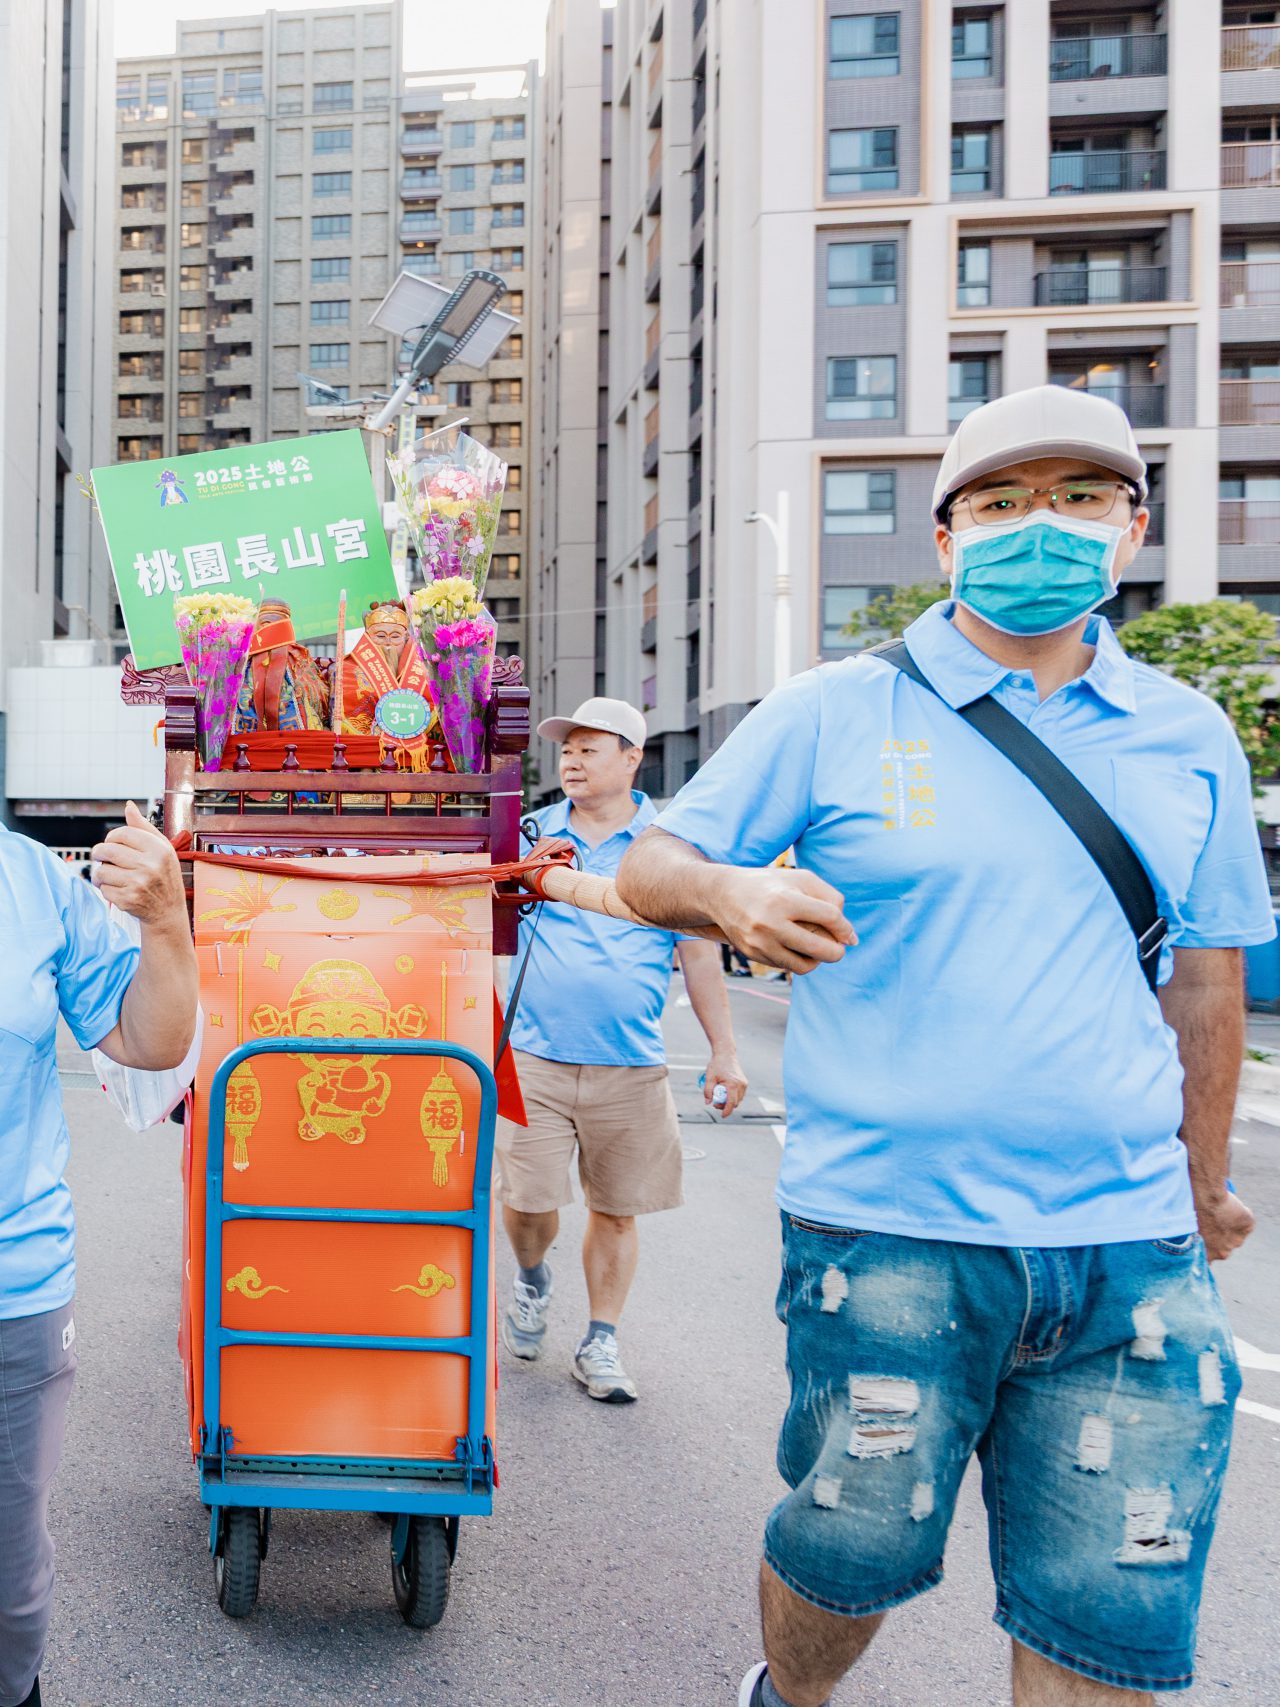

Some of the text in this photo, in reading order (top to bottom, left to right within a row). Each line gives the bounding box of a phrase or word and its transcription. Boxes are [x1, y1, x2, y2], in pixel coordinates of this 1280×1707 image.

[133, 518, 369, 597] 桃園長山宮
[367, 662, 382, 681] GOOD
[390, 711, 416, 726] 3-1
[226, 1084, 257, 1116] 福
[424, 1099, 458, 1131] 福
